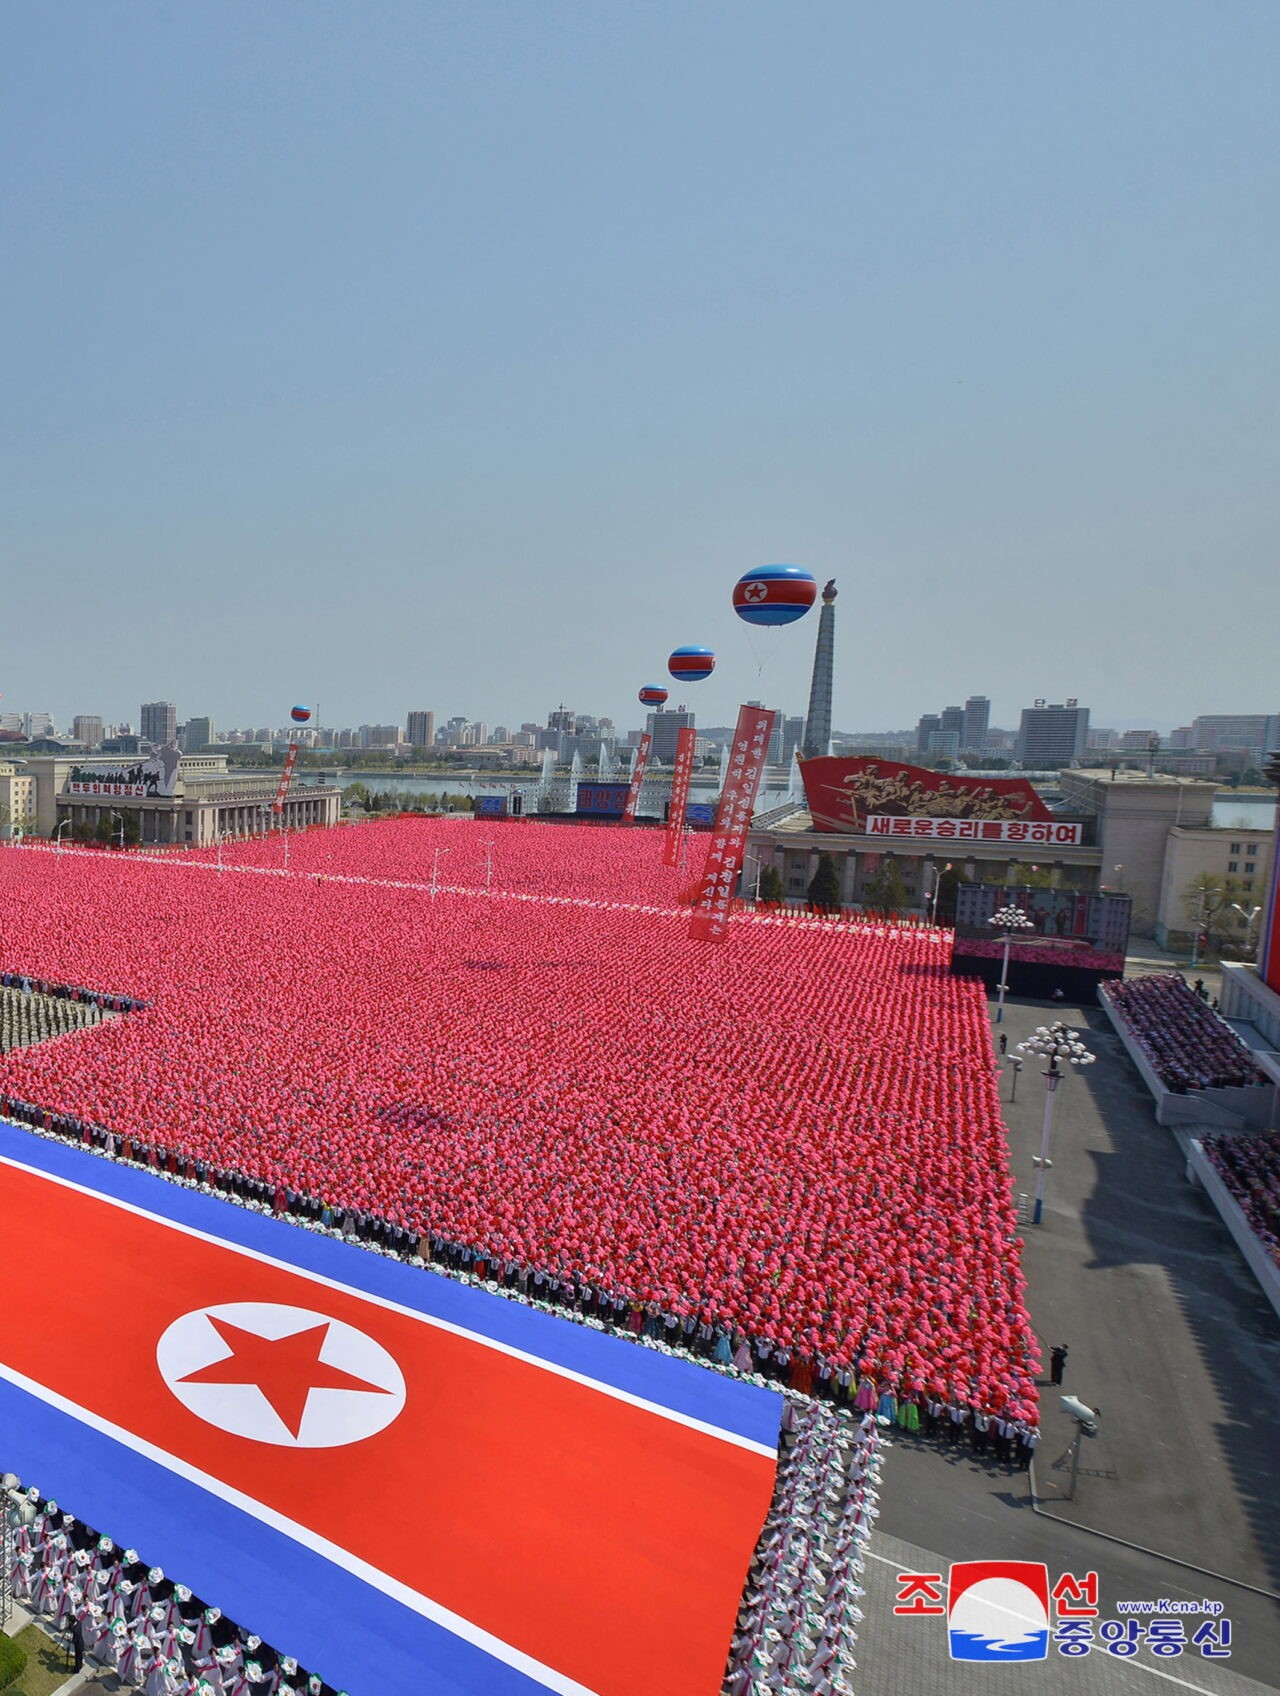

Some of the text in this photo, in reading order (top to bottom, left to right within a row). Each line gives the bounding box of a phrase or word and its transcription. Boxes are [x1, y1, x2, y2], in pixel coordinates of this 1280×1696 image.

[752, 720, 768, 759] 위대한
[626, 741, 649, 815] 결사옹위
[731, 741, 748, 779] 영원히
[720, 790, 738, 828] 우리와
